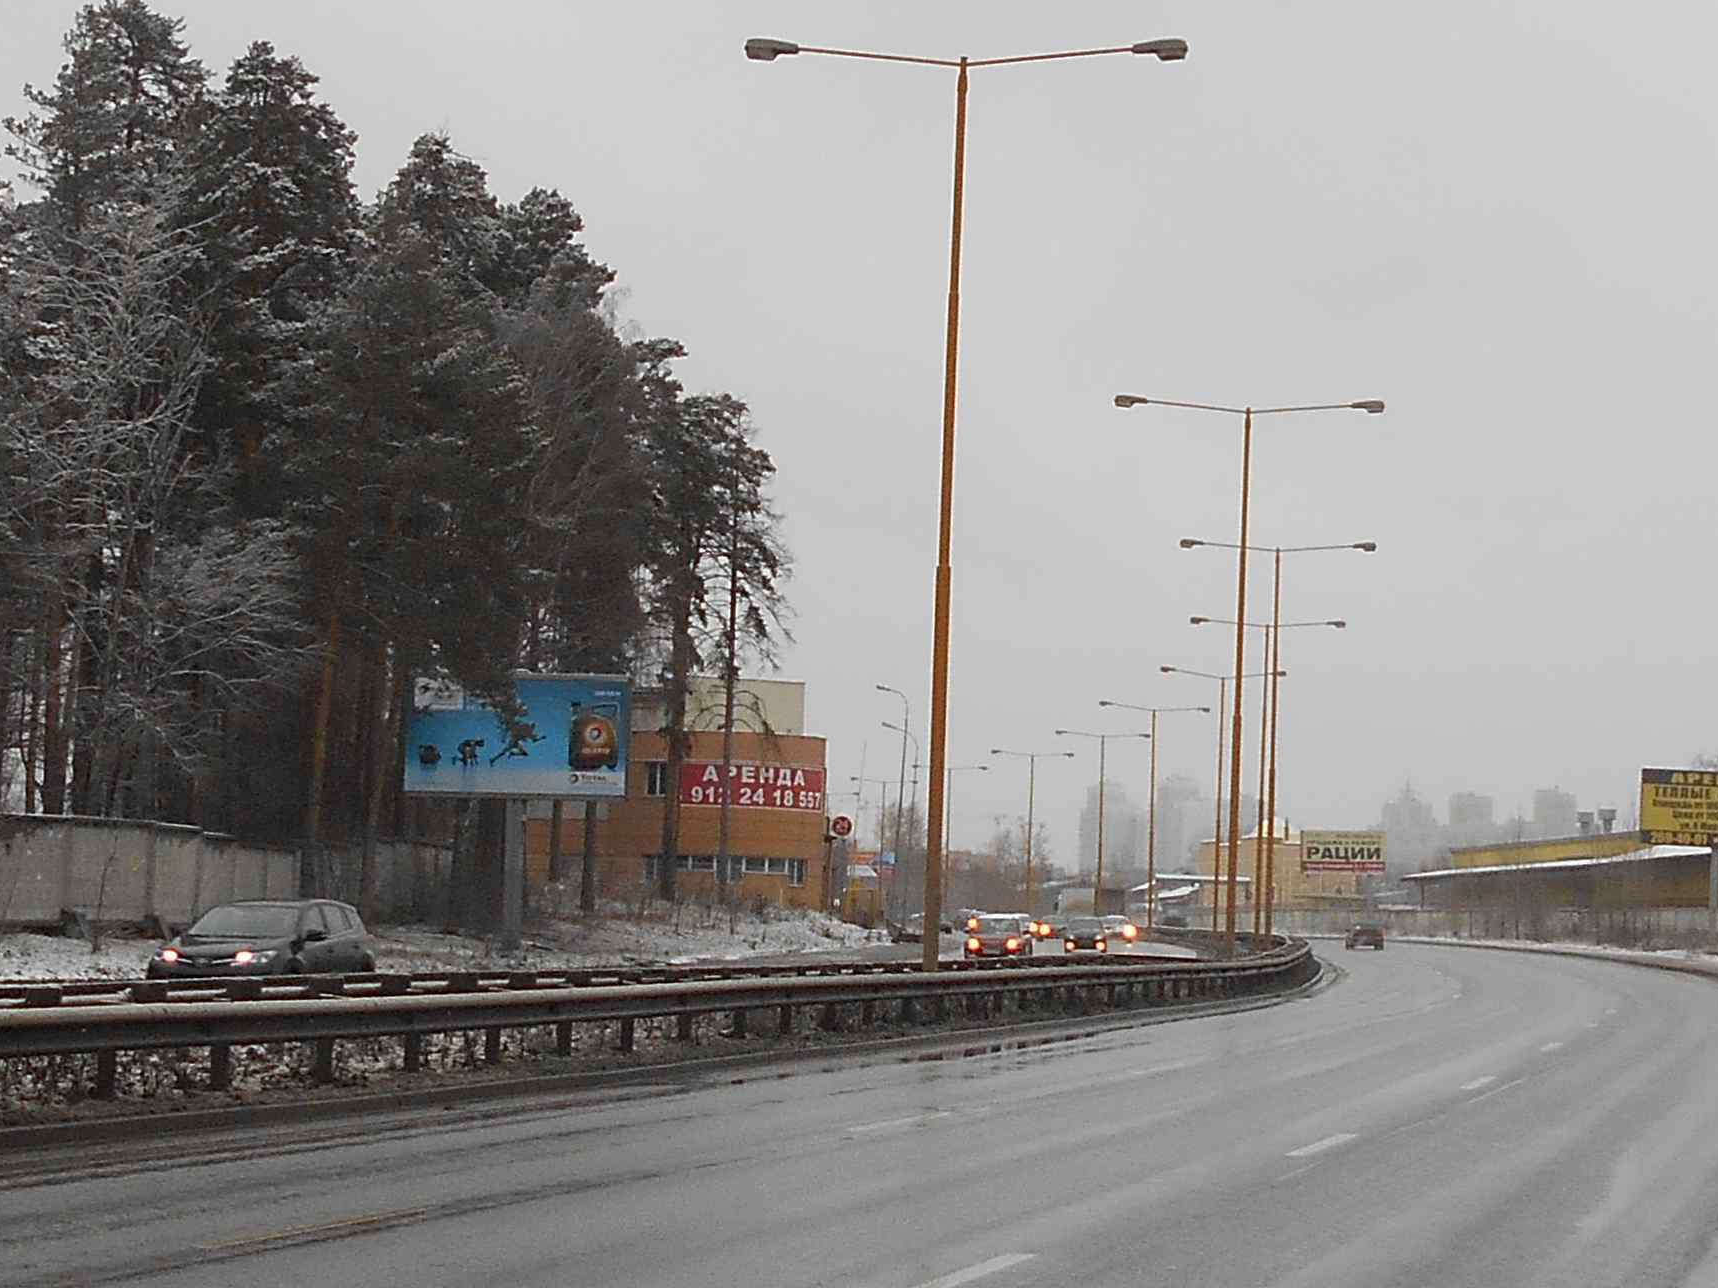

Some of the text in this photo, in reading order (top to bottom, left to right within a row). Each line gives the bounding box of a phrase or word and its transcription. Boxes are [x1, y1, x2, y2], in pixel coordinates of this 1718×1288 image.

[739, 787, 765, 805] 24
[773, 790, 794, 807] 18
[798, 792, 821, 810] 557
[1306, 846, 1381, 863] РАЦИИ
